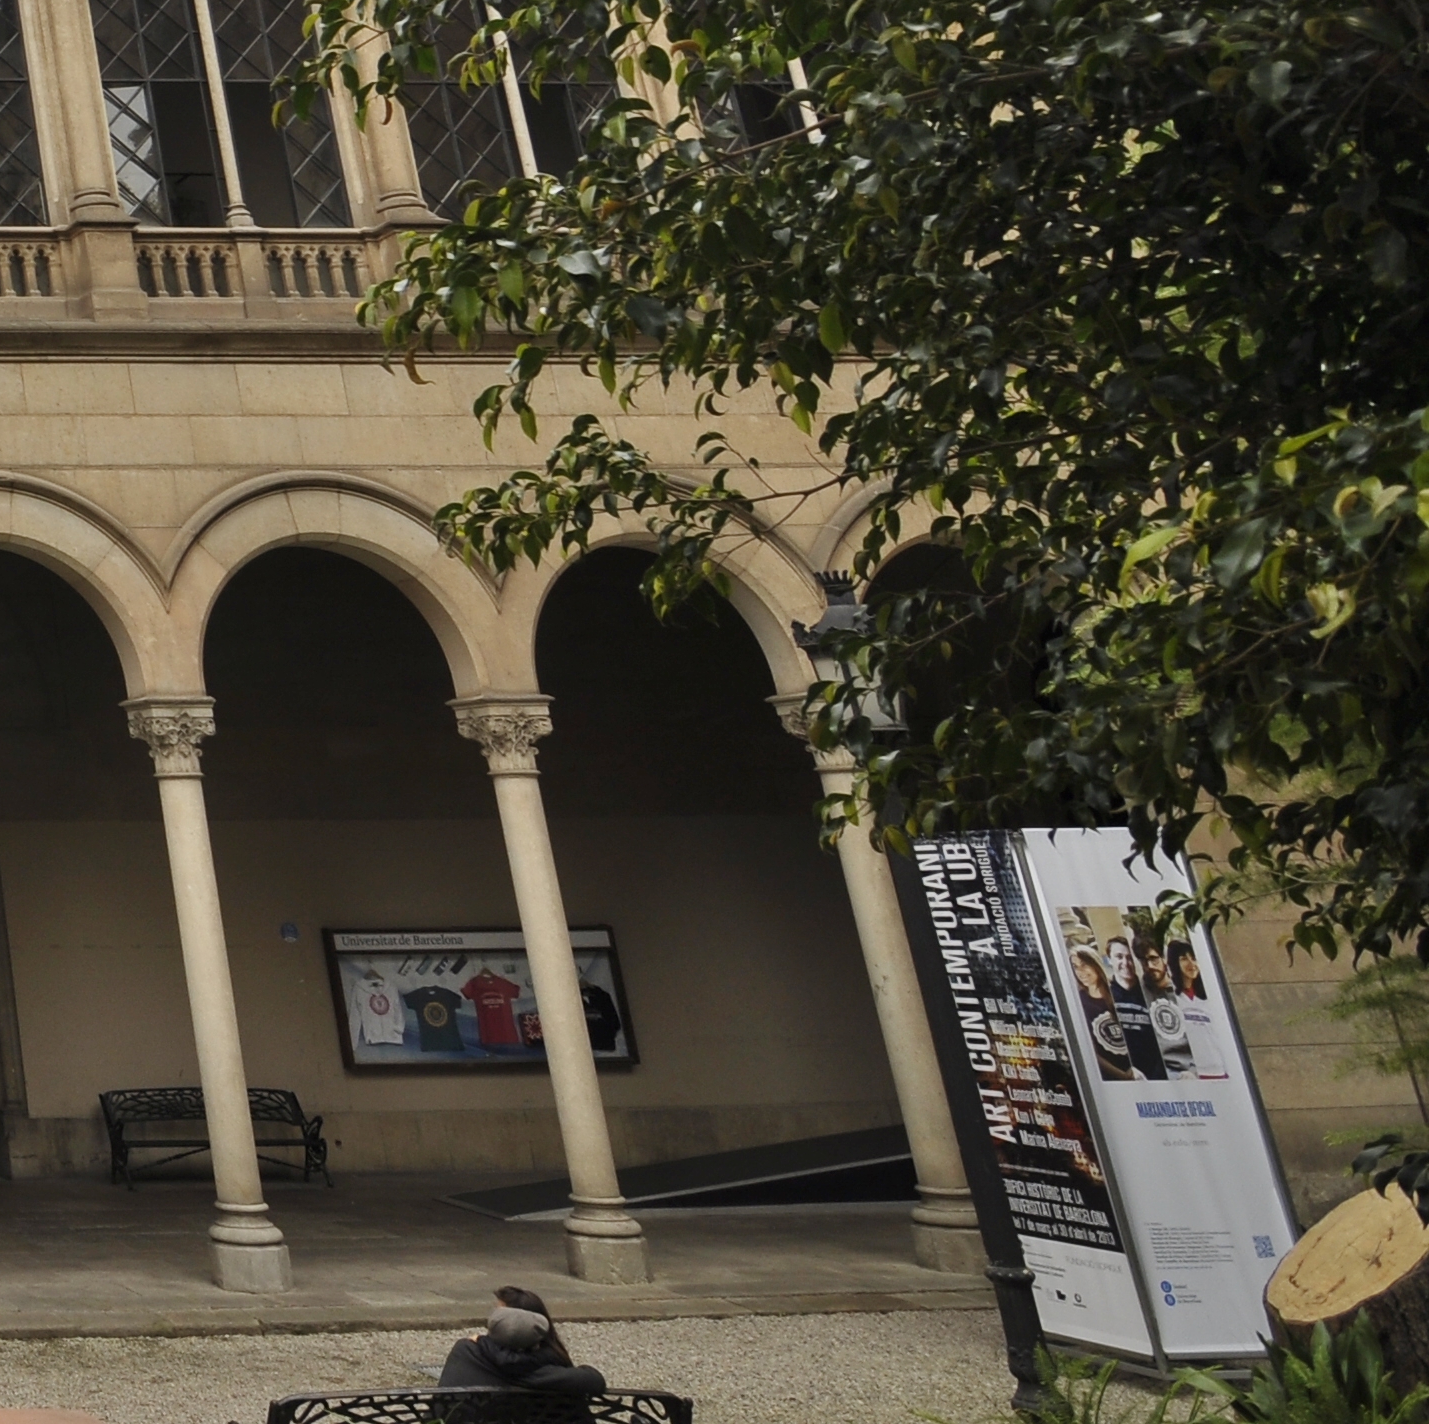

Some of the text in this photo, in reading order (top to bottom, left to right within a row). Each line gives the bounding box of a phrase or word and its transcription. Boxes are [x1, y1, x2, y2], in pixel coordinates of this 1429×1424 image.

[942, 843, 999, 956] A LA UB
[986, 896, 1017, 957] FUNDACIÓ
[340, 934, 464, 947] Universitat de Barcelona
[914, 844, 1018, 1144] ART CONTEMPORANI
[1007, 1084, 1039, 1104] Leonard
[1187, 1101, 1217, 1117] OFICIAL
[1019, 1129, 1048, 1148] Marina
[1060, 1187, 1074, 1205] DE
[1072, 1188, 1085, 1206] LA
[1051, 1203, 1064, 1221] DE
[1063, 1205, 1111, 1228] BARCELONA
[1026, 1218, 1036, 1232] de
[1034, 1222, 1052, 1237] març
[1087, 1229, 1097, 1243] de
[1096, 1229, 1116, 1245] 2013
